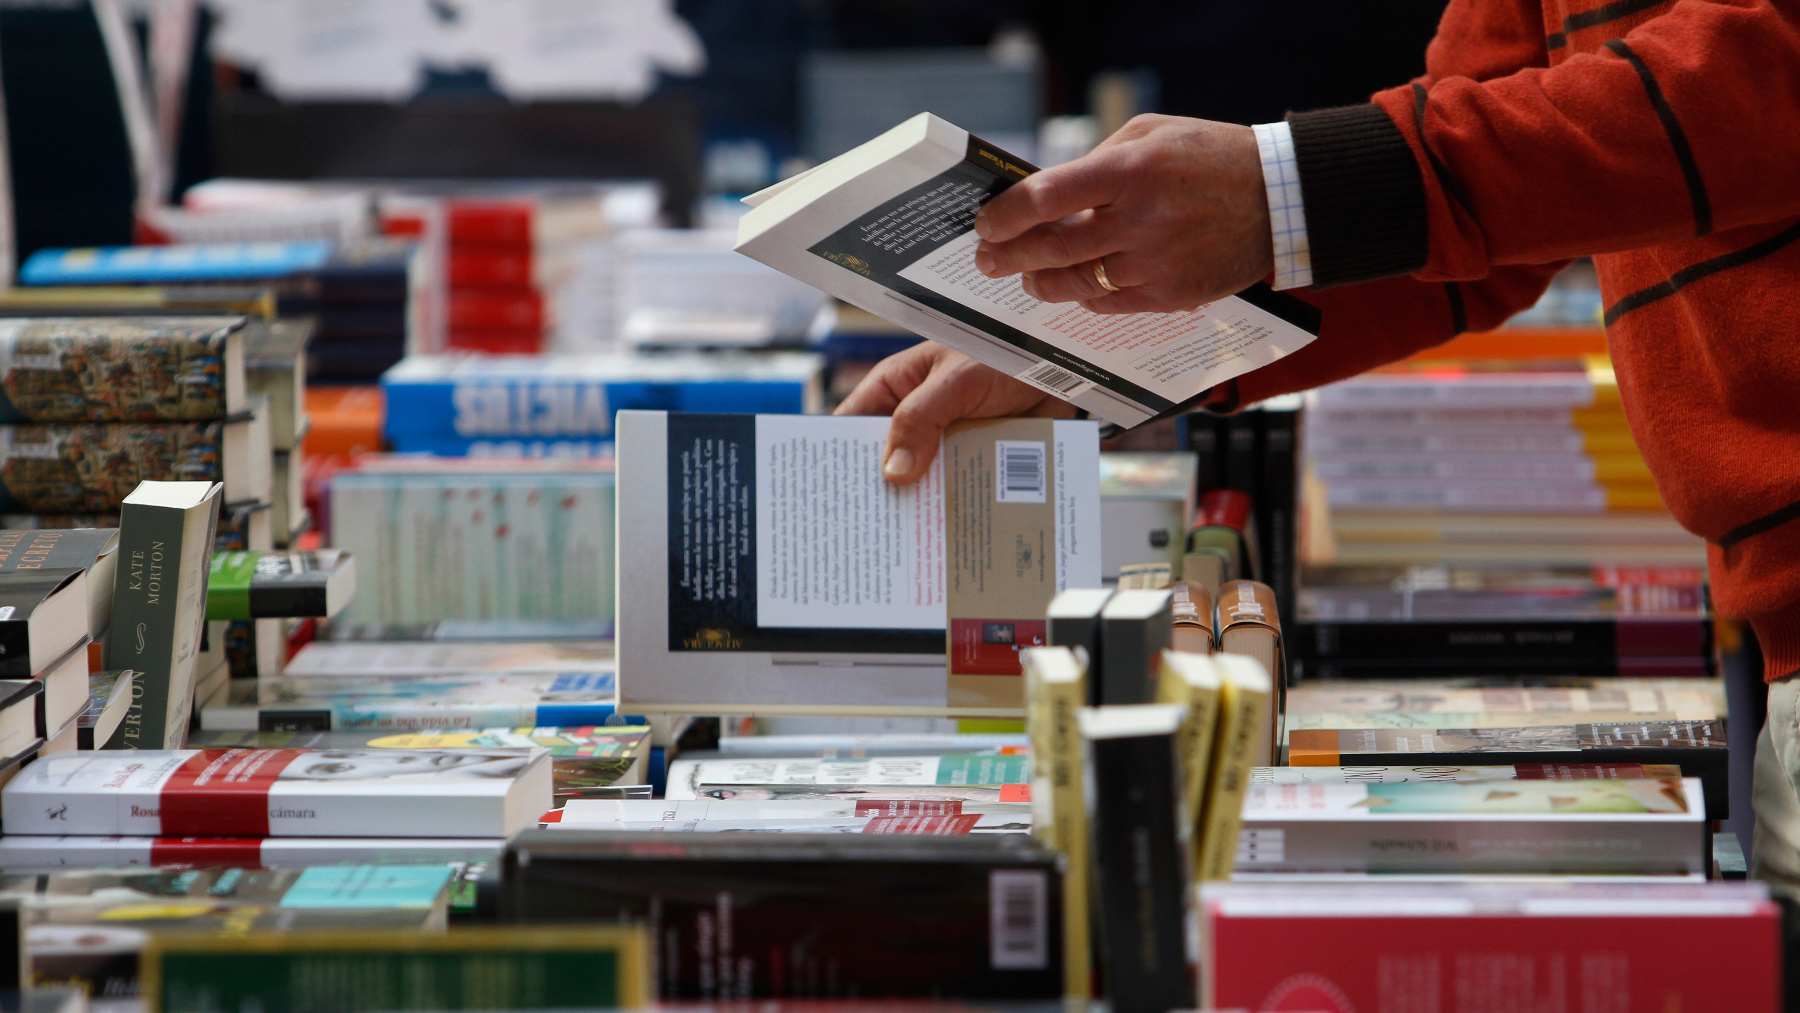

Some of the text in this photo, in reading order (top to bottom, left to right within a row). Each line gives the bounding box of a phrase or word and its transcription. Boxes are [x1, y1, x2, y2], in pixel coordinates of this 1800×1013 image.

[453, 374, 610, 437] VICTUS
[128, 551, 144, 590] KATE
[148, 541, 165, 606] MORTON
[122, 671, 146, 750] VERTON
[130, 804, 316, 819] Rosa cámara
